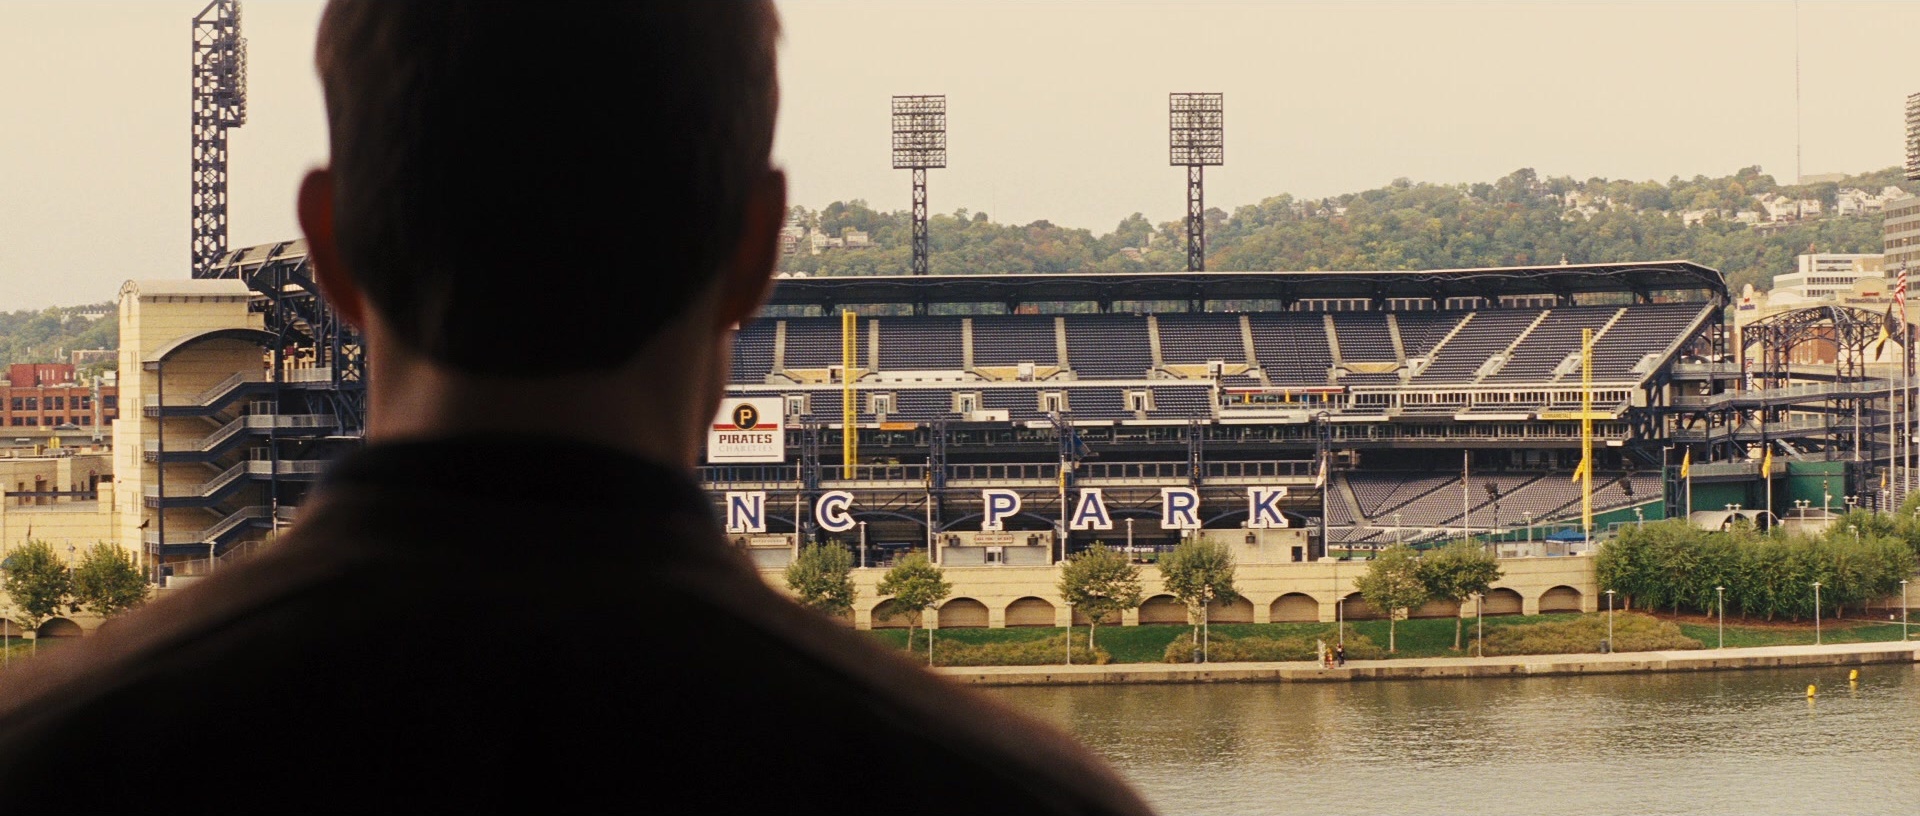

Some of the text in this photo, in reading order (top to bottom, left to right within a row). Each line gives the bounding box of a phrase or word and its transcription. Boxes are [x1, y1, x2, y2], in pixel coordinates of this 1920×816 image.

[740, 409, 752, 425] P
[719, 434, 773, 444] PIRATES
[719, 445, 773, 453] CHARITIES
[982, 485, 1290, 531] PARK
